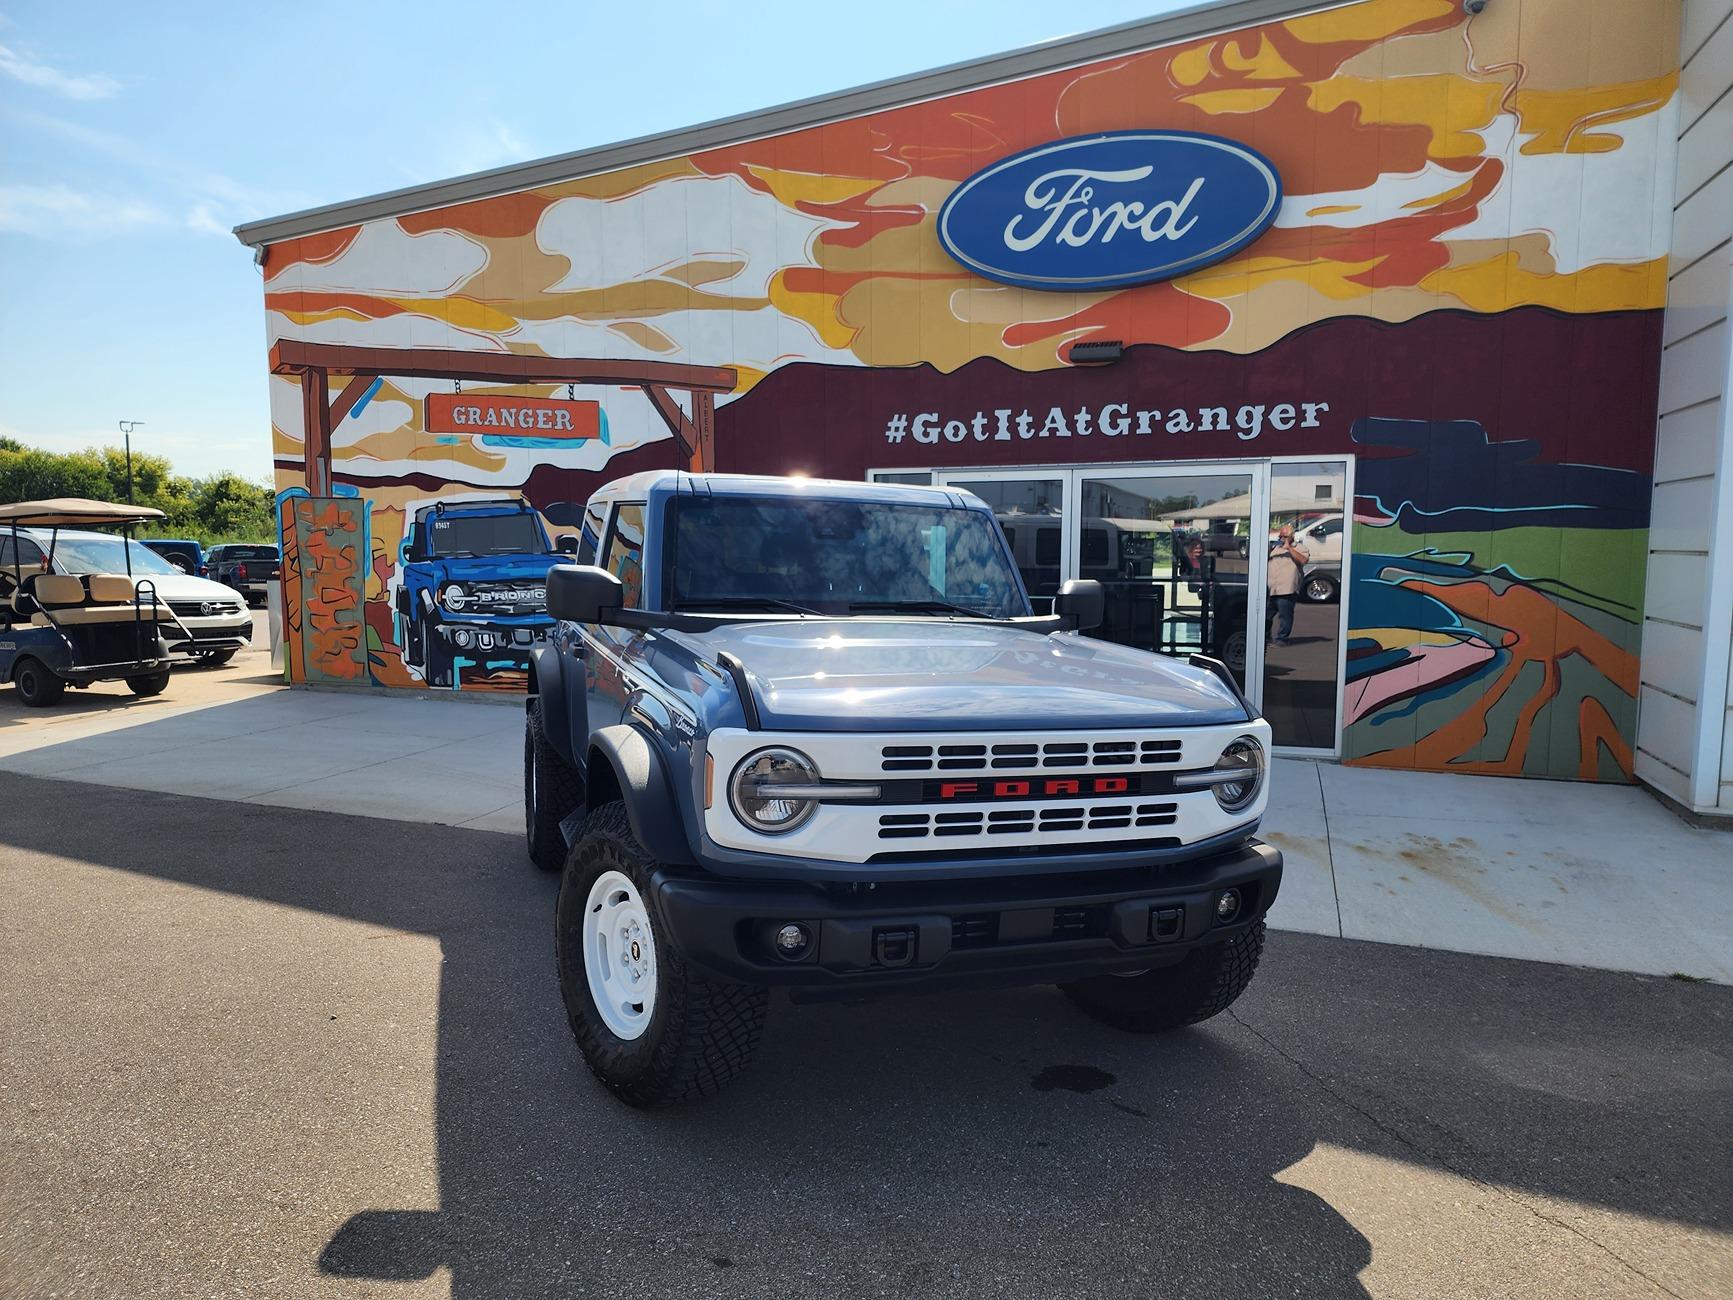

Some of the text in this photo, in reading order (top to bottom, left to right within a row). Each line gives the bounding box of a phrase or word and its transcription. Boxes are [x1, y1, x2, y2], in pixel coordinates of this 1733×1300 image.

[1003, 165, 1206, 252] Ford
[452, 406, 575, 430] GRANGER
[885, 401, 1330, 443] #GotItAtGranger
[480, 589, 547, 602] BRONC
[940, 777, 1128, 798] FORD
